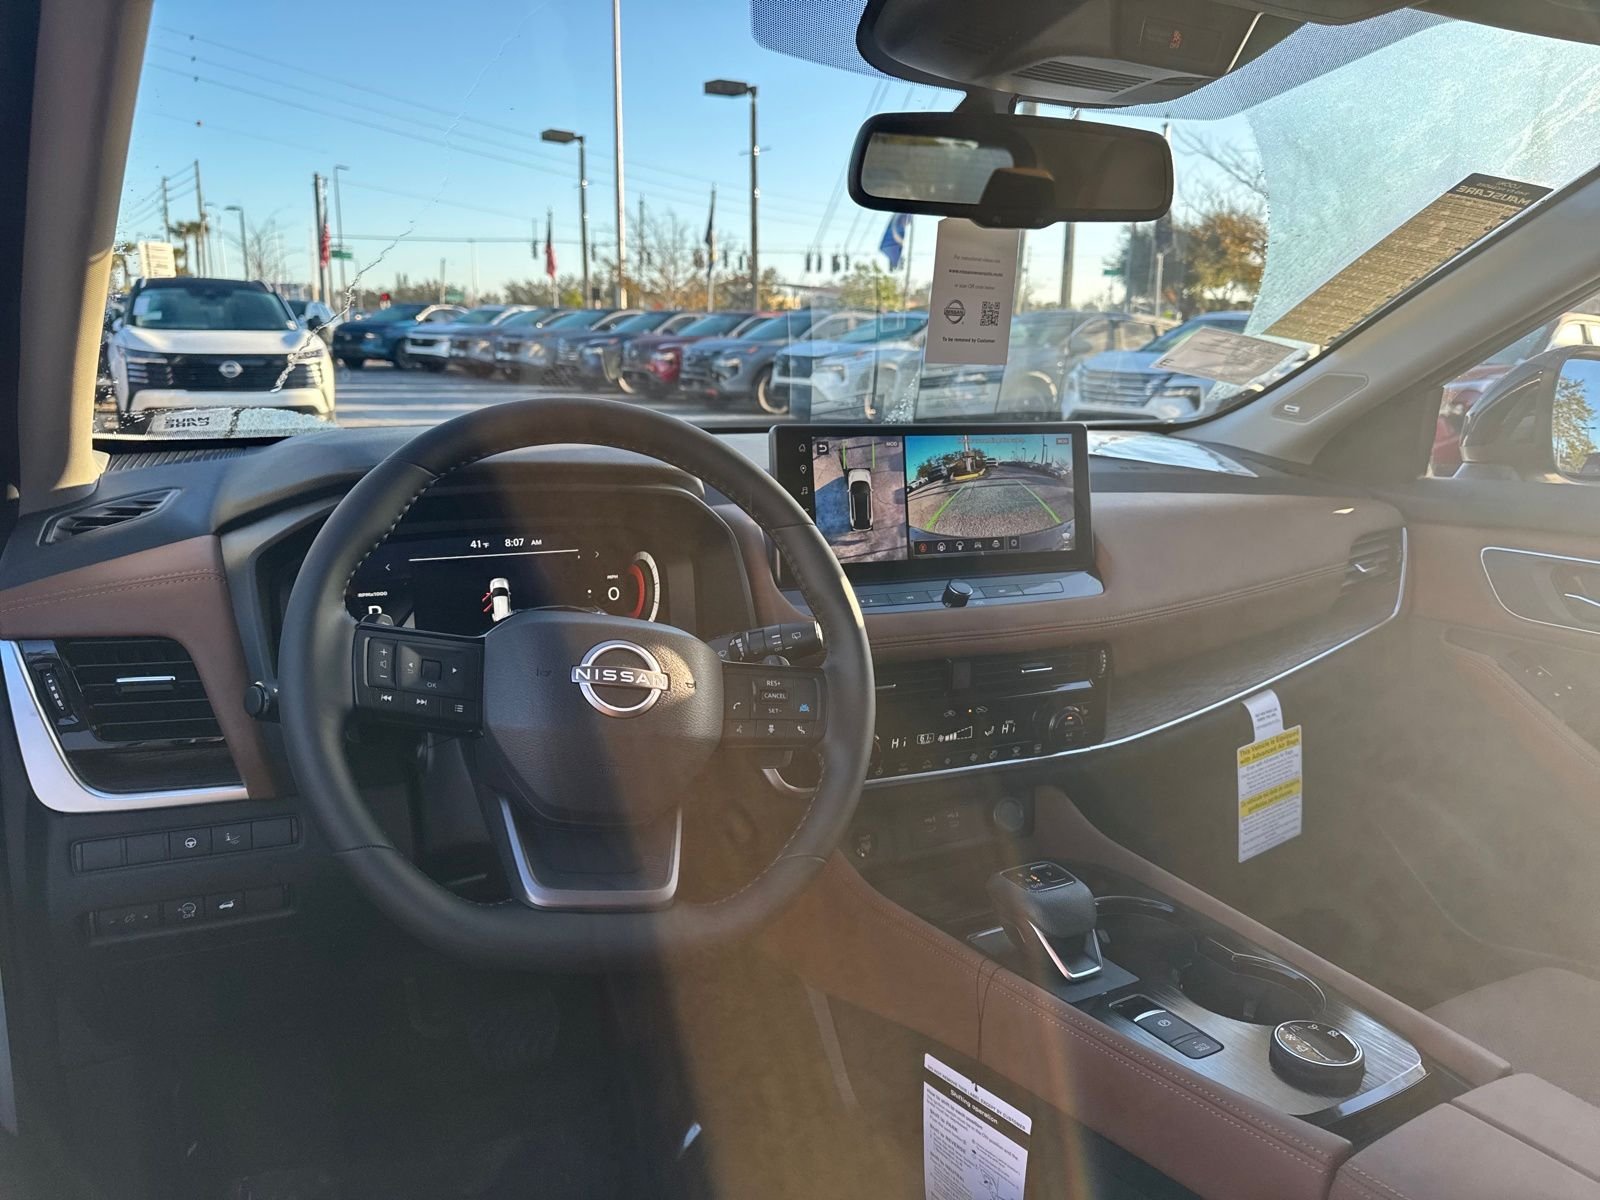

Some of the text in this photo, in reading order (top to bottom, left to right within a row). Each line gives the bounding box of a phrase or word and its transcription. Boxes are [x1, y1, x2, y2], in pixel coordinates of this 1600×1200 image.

[504, 538, 524, 548] 8:07
[574, 668, 667, 689] NISSAN
[950, 1088, 997, 1125] Shifting operation
